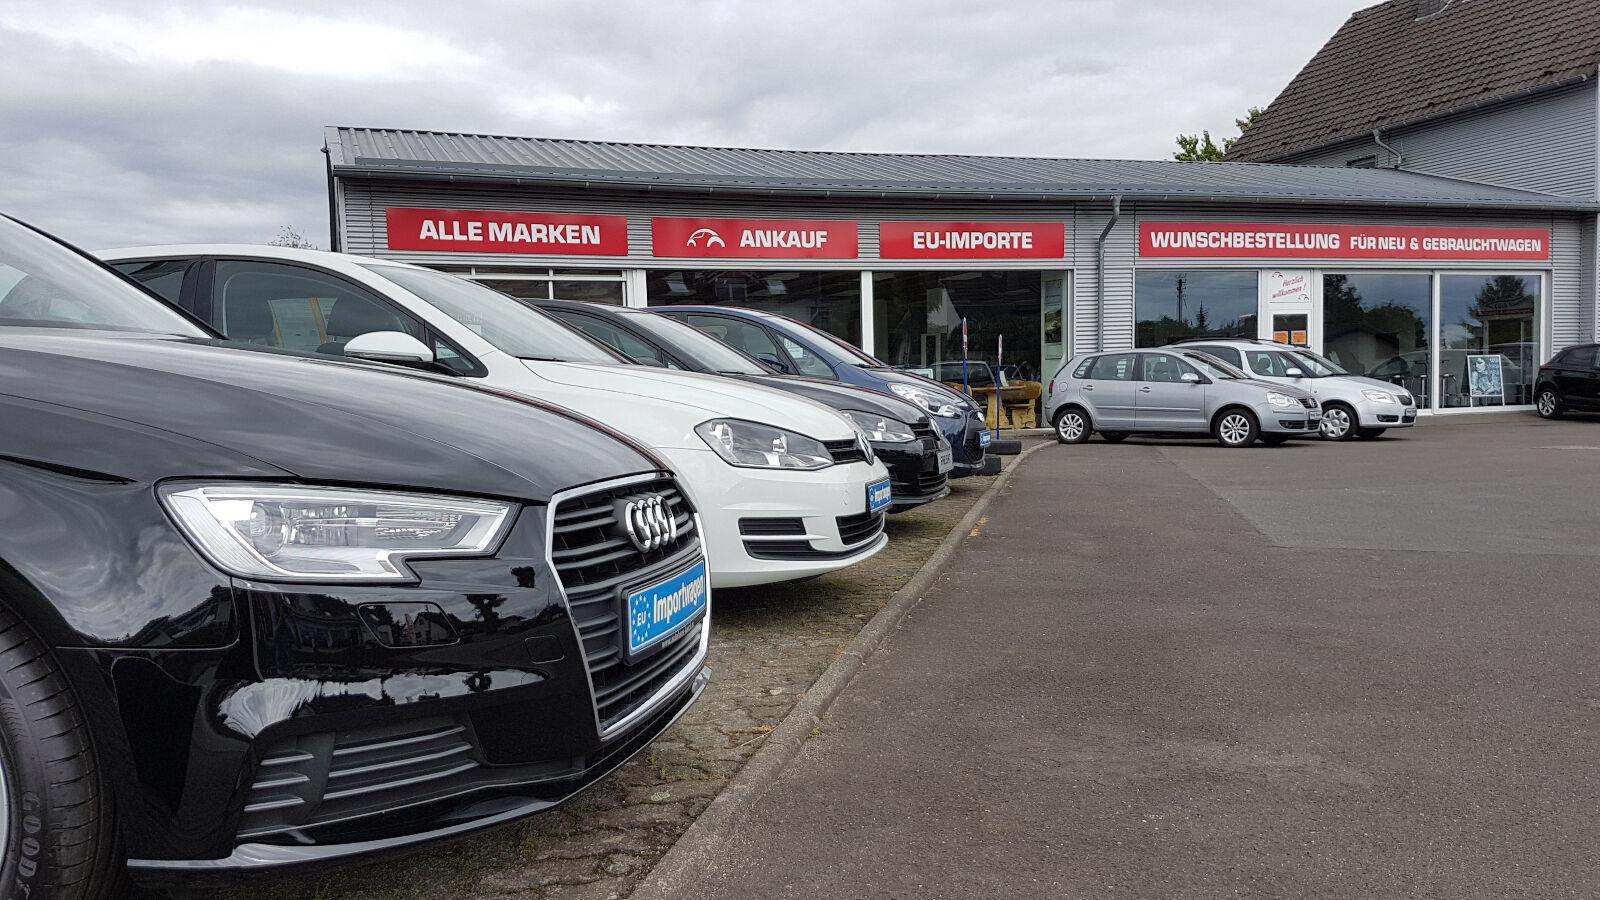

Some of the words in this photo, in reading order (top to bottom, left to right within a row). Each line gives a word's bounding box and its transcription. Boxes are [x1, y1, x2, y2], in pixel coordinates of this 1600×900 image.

[419, 219, 483, 243] ALLE
[488, 222, 601, 245] MARKEN
[739, 229, 828, 249] ANKAUF
[913, 231, 1033, 250] EU-IMPORTE
[1150, 231, 1341, 250] WUNSCHBESTELLUNG
[1350, 234, 1377, 250] FÜR
[1377, 236, 1406, 251] NEU
[1409, 237, 1420, 251] &
[1422, 237, 1541, 252] GEBRAUCHTWAGEN
[637, 611, 647, 627] EU
[653, 574, 704, 624] Importwagen
